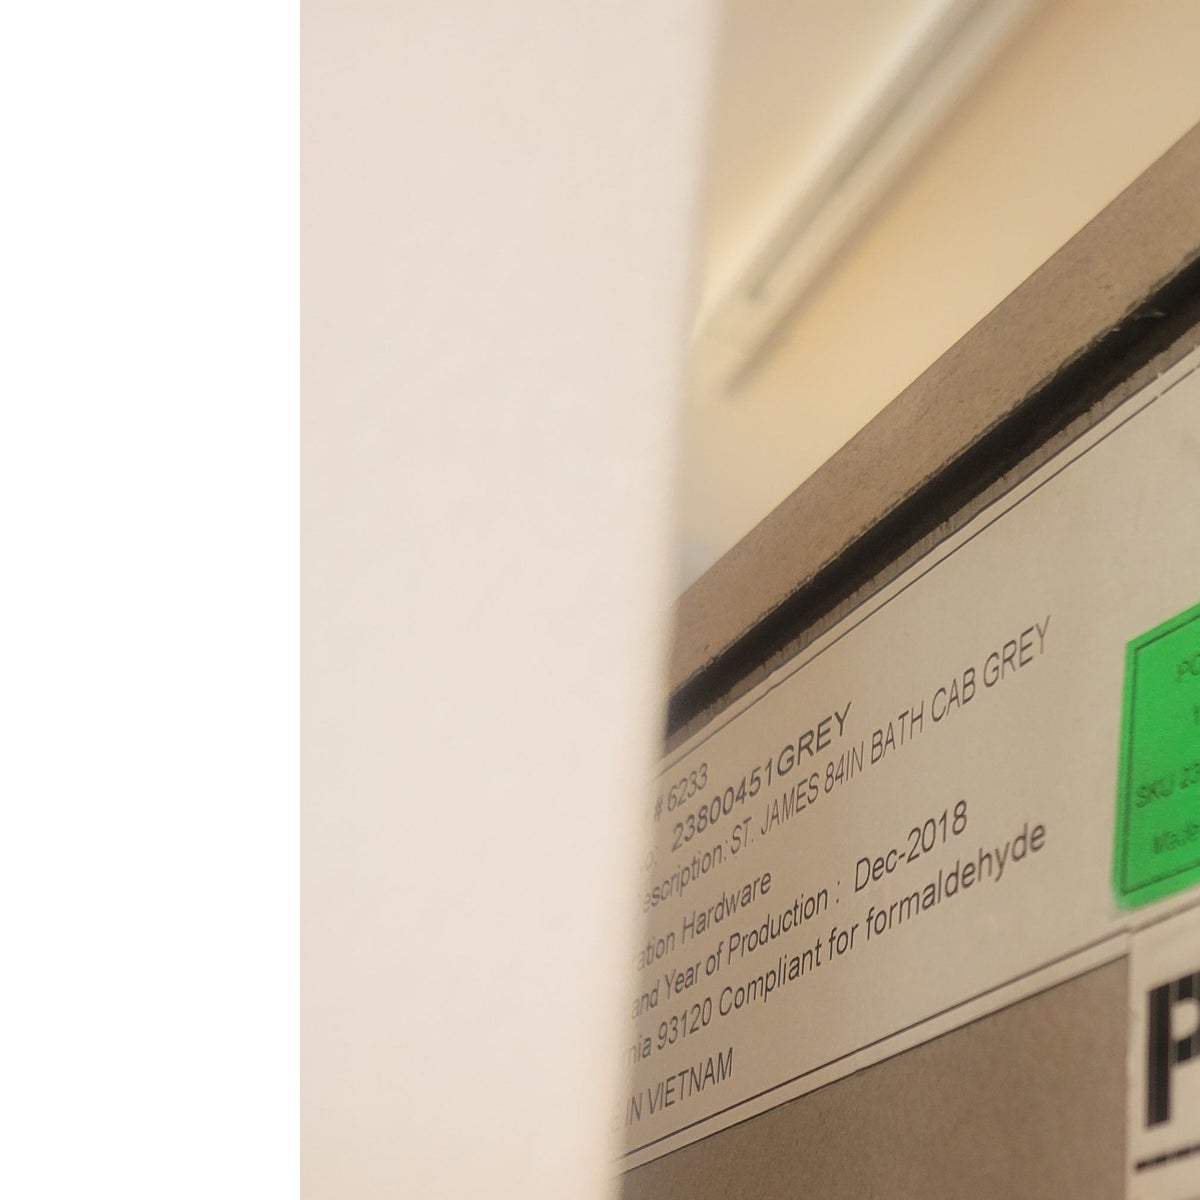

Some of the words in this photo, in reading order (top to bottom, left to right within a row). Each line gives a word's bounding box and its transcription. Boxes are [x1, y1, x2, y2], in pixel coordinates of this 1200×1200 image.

[667, 762, 708, 813] 6233
[671, 701, 852, 853] 23800451GREY
[760, 771, 820, 836] JAMES
[824, 741, 864, 795] 84IN
[871, 700, 925, 765] BATH
[931, 667, 976, 722] CAB
[983, 615, 1051, 688] GREY
[1136, 774, 1176, 808] SKU
[635, 931, 675, 972] ation
[682, 872, 772, 945] Hardware
[657, 997, 713, 1050] 93120
[719, 938, 823, 1017] Compliant
[829, 919, 860, 960] for
[867, 822, 1046, 941] formaldehyde
[665, 961, 702, 1000] Year
[706, 941, 725, 976] of
[728, 888, 829, 965] Production
[855, 800, 968, 893] Dec-2018
[648, 1047, 734, 1115] VIETNAM
